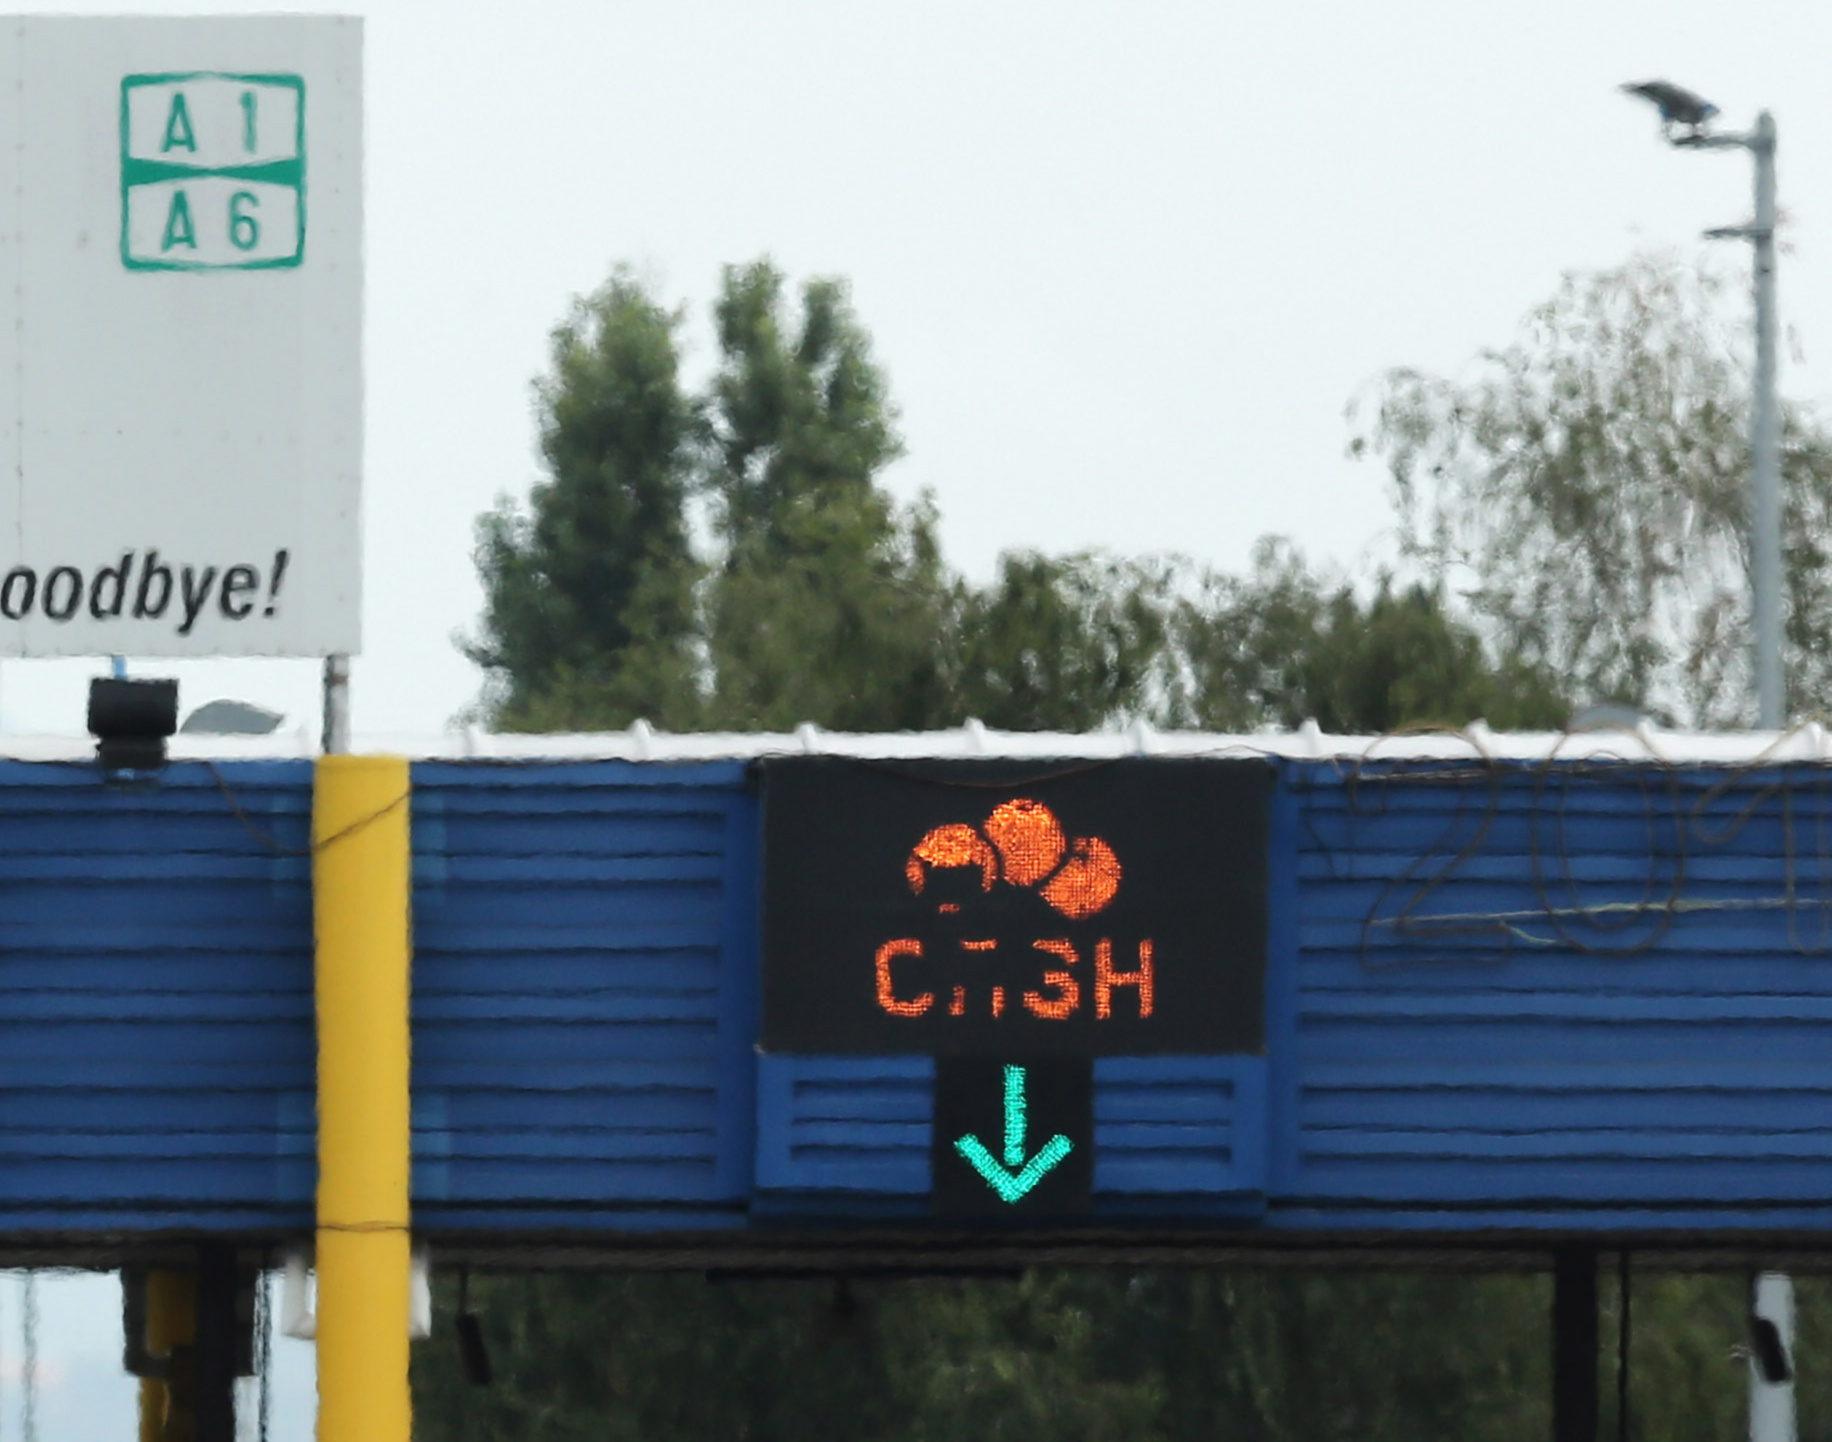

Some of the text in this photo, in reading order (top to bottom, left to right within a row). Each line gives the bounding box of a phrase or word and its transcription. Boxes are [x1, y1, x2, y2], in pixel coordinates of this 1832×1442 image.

[162, 90, 259, 154] A 1
[160, 188, 260, 251] A 6
